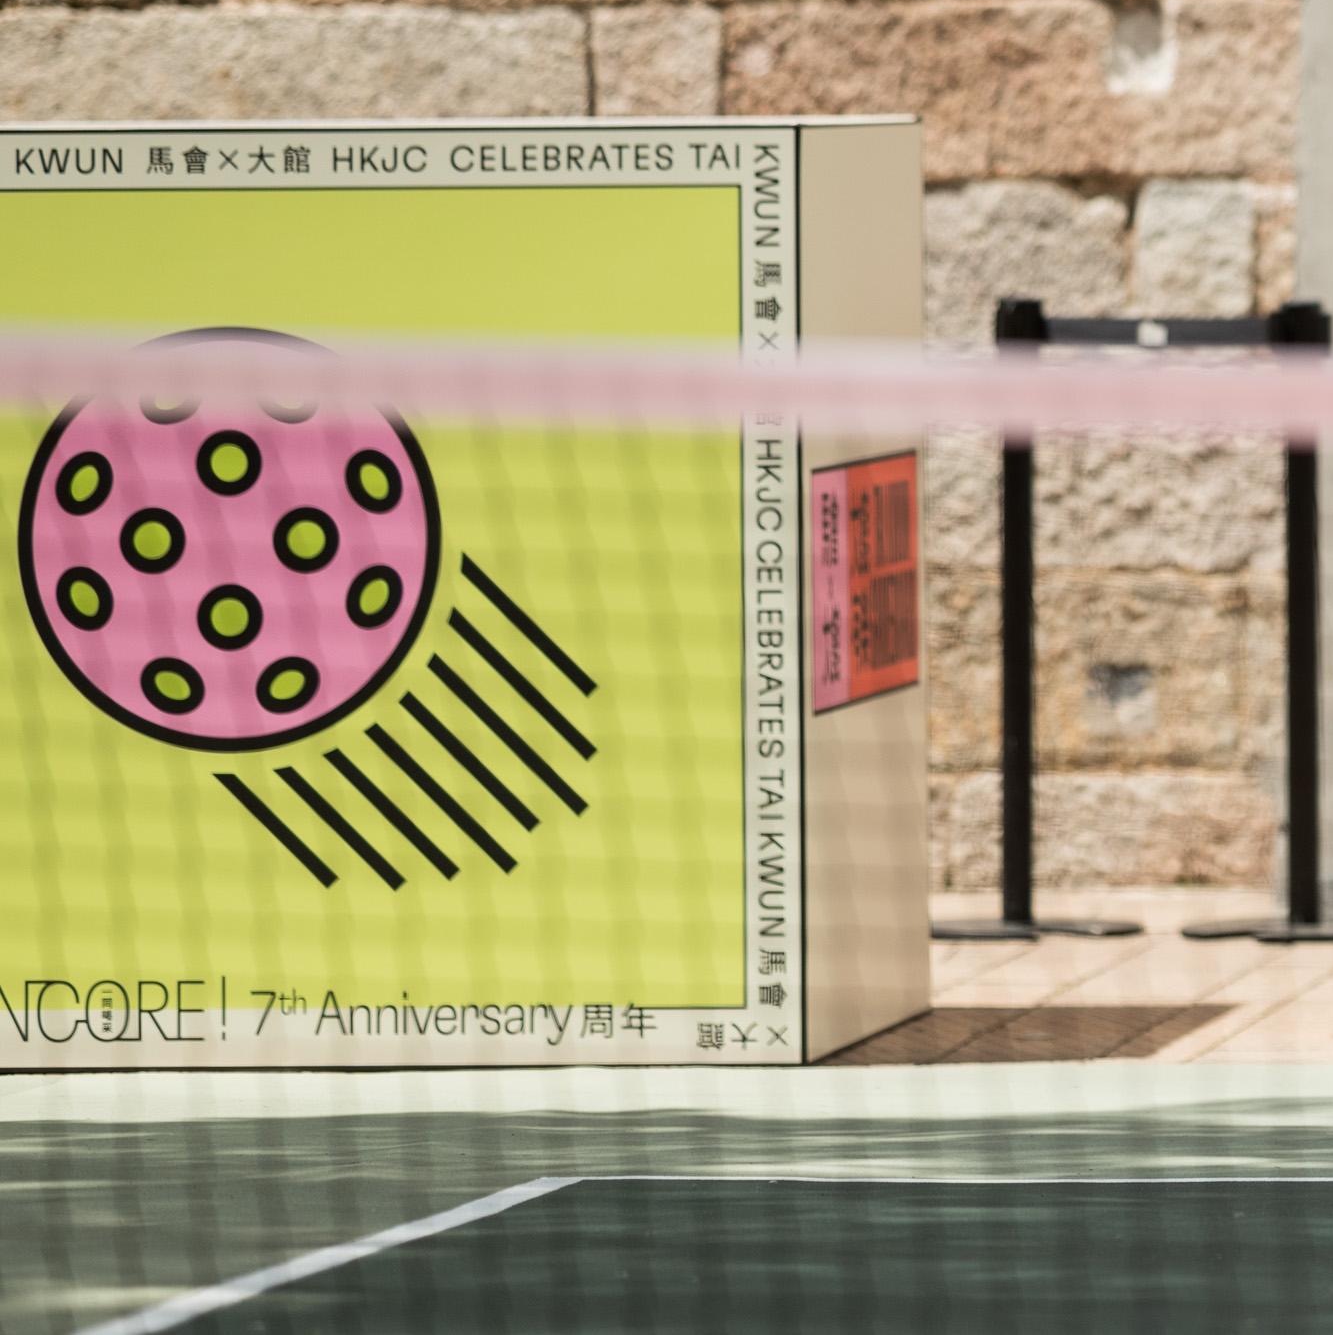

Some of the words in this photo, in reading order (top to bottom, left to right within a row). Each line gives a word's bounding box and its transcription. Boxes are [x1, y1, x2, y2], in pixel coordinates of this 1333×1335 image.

[16, 148, 122, 174] KWUN
[333, 146, 427, 172] HKJC
[450, 144, 672, 172] CELEBRATES
[689, 144, 739, 169] TAI
[754, 145, 779, 246] KWUN
[756, 440, 782, 531] HKJC
[757, 541, 784, 758] CELEBRATES
[759, 770, 784, 820] TAI
[758, 833, 784, 937] KWUN
[0, 975, 227, 1043] NCORE!
[316, 990, 573, 1046] Anniversary
[580, 1002, 658, 1039] 周年
